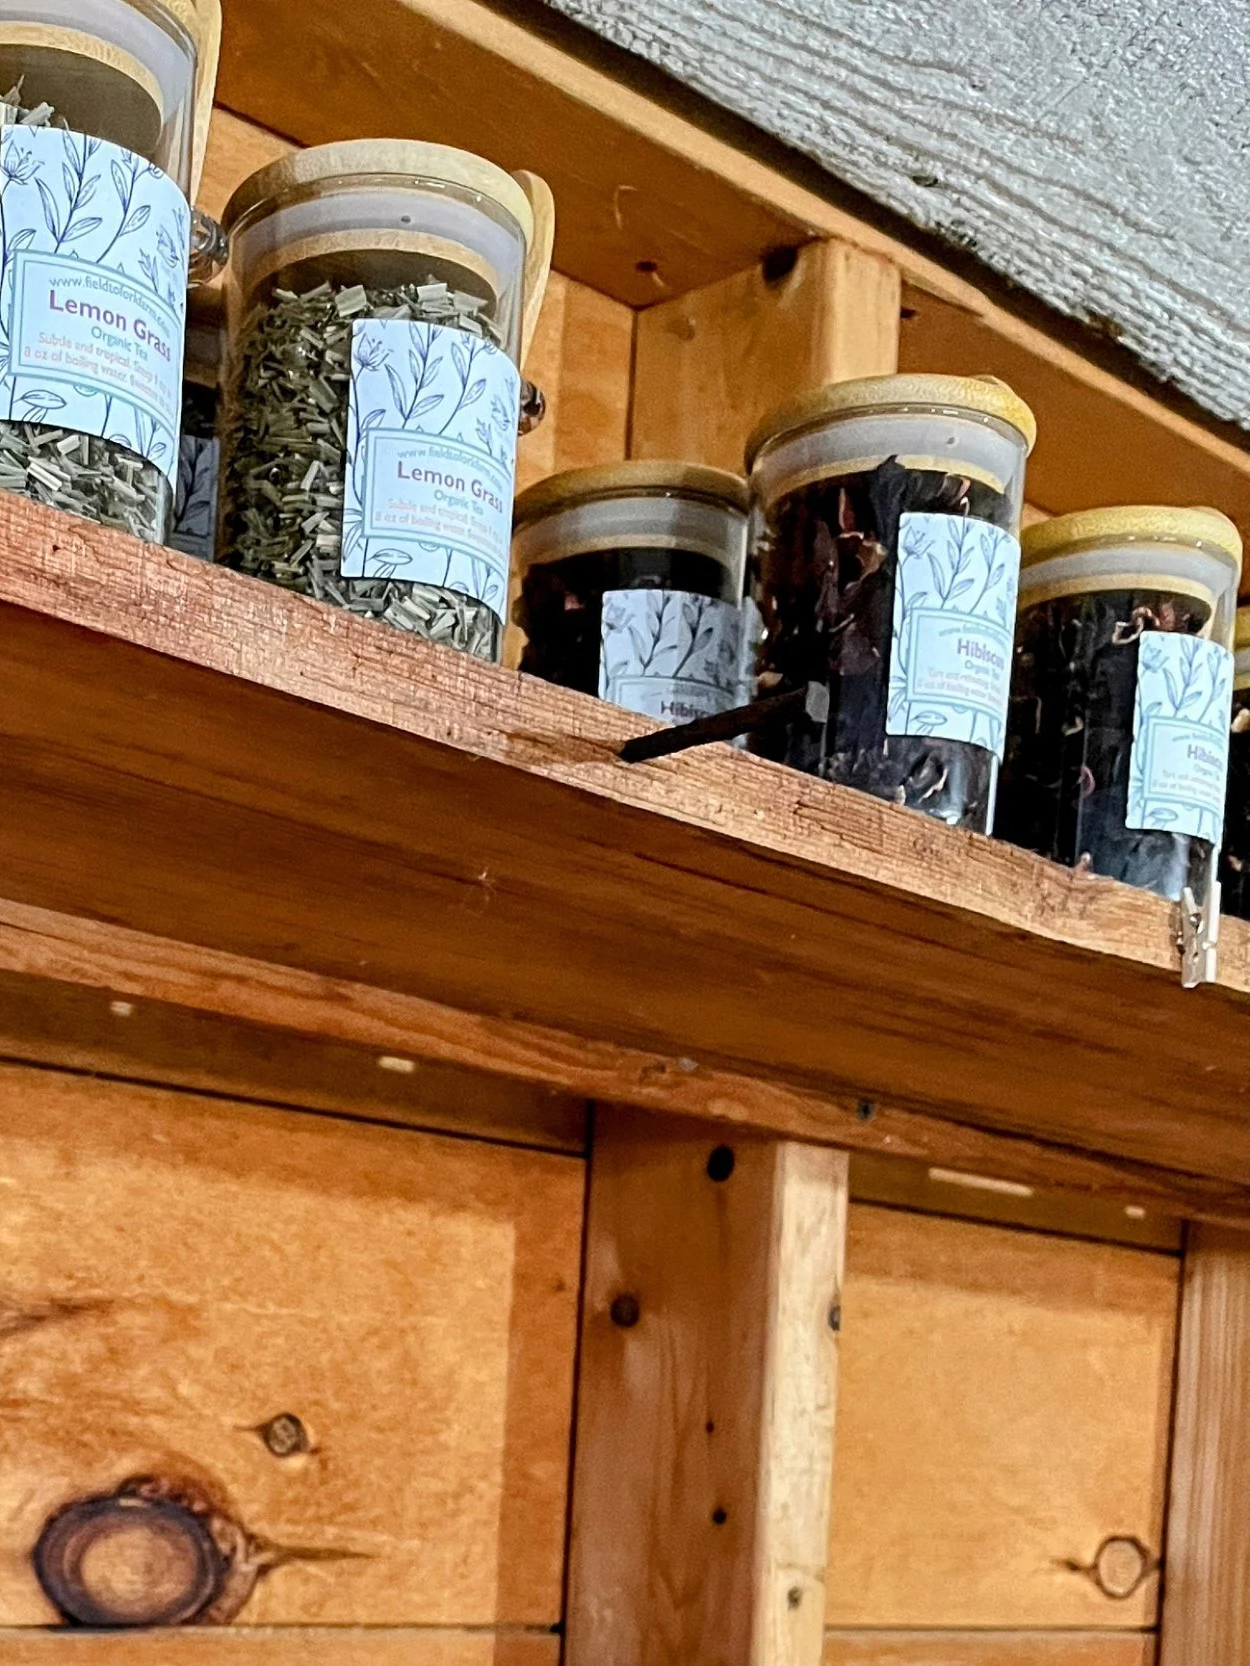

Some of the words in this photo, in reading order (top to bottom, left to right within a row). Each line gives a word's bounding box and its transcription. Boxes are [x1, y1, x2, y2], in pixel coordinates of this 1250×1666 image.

[49, 290, 126, 331] Lemon
[133, 319, 171, 362] Grass
[91, 326, 132, 352] Organic
[134, 342, 148, 361] Tea
[397, 461, 465, 492] Lemon
